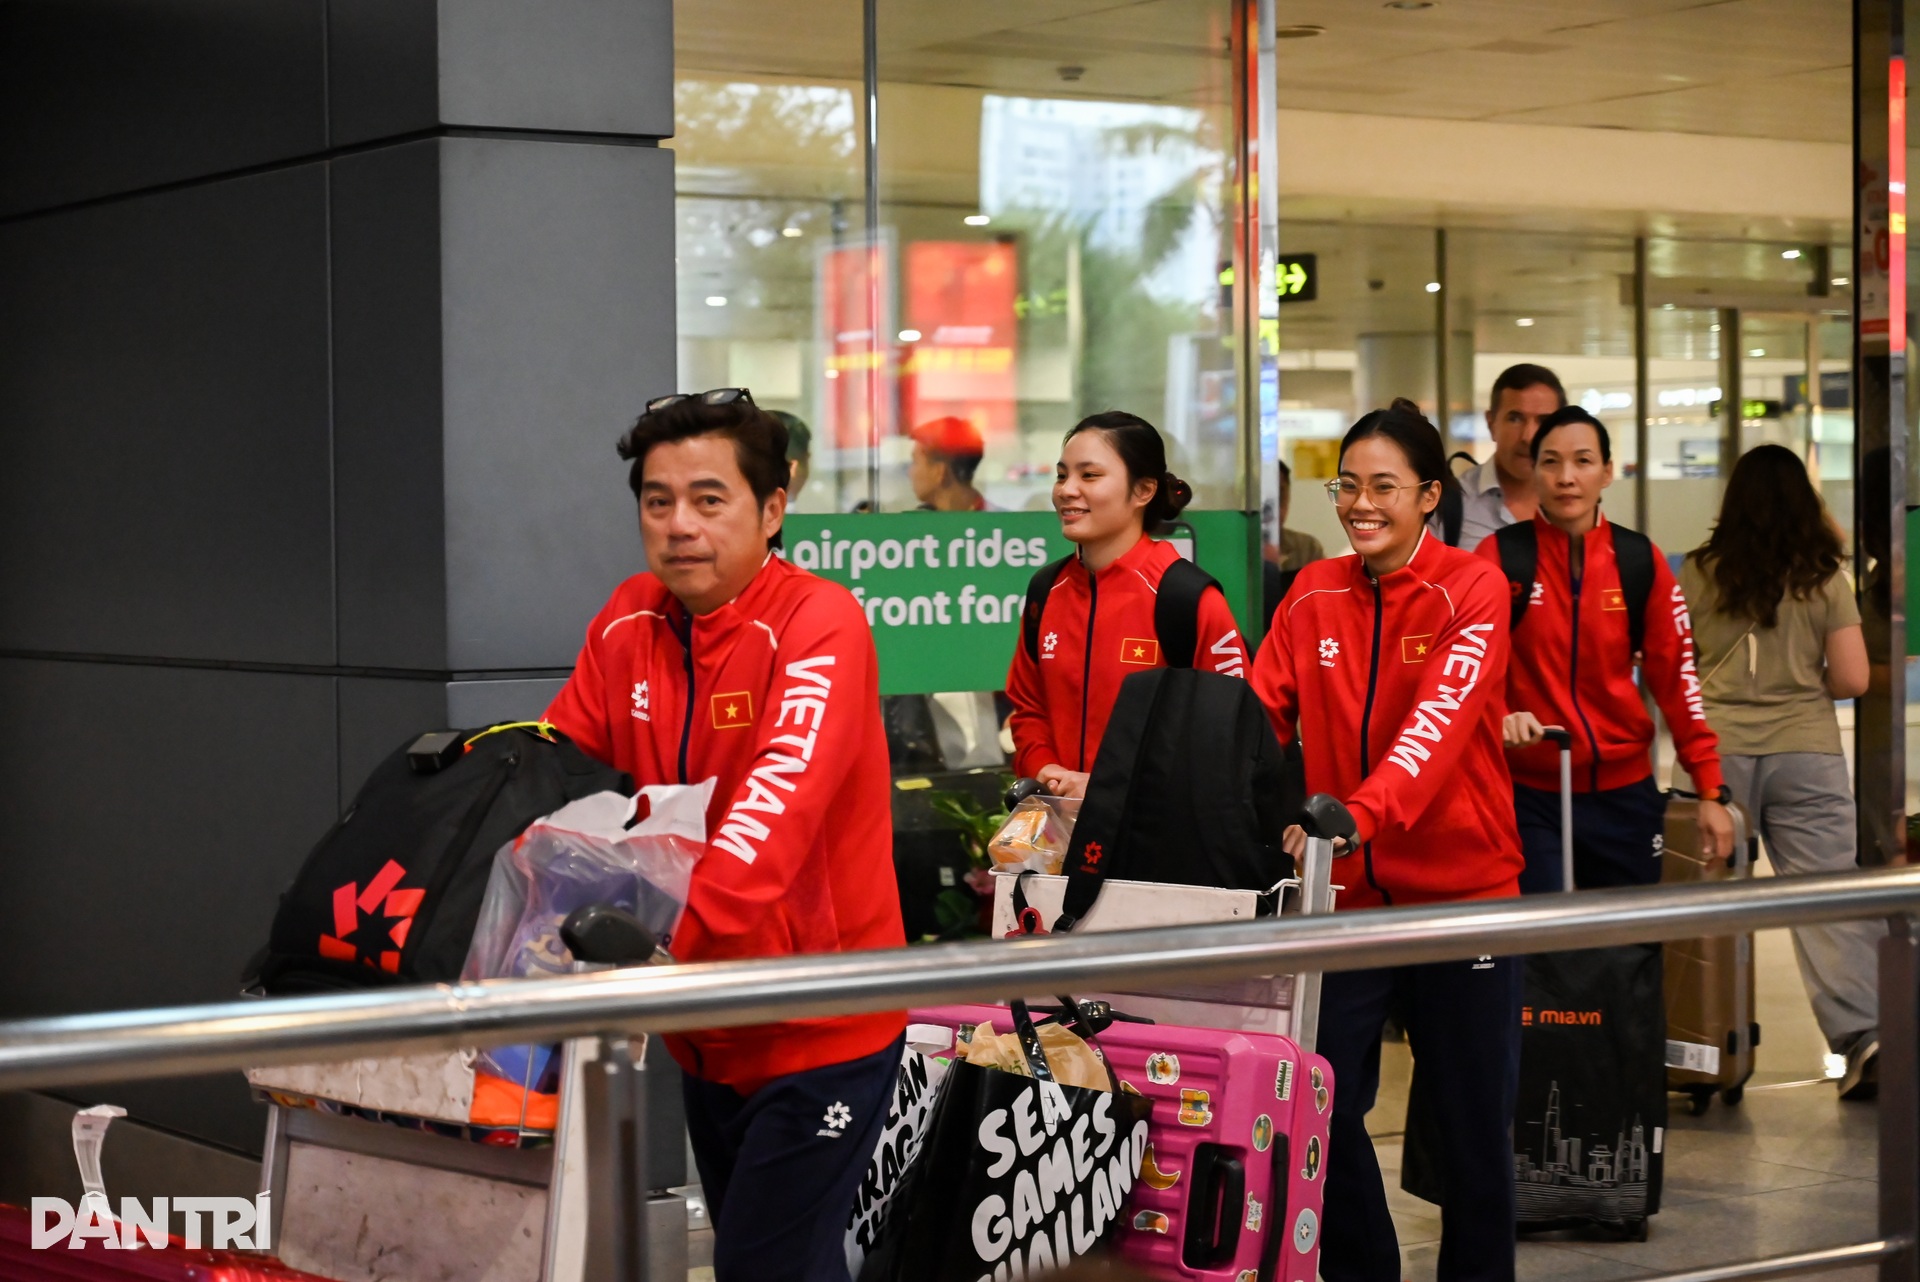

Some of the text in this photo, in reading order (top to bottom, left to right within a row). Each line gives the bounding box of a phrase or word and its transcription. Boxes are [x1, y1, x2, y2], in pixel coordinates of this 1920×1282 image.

[793, 527, 1048, 580] airport rides
[712, 655, 836, 865] VIETNAM
[1387, 623, 1494, 778] VIETNAM
[1540, 1010, 1602, 1025] mia.vn
[971, 1092, 1116, 1262] GAMES
[976, 1119, 1149, 1282] AILAND
[978, 1080, 1072, 1179] SEA
